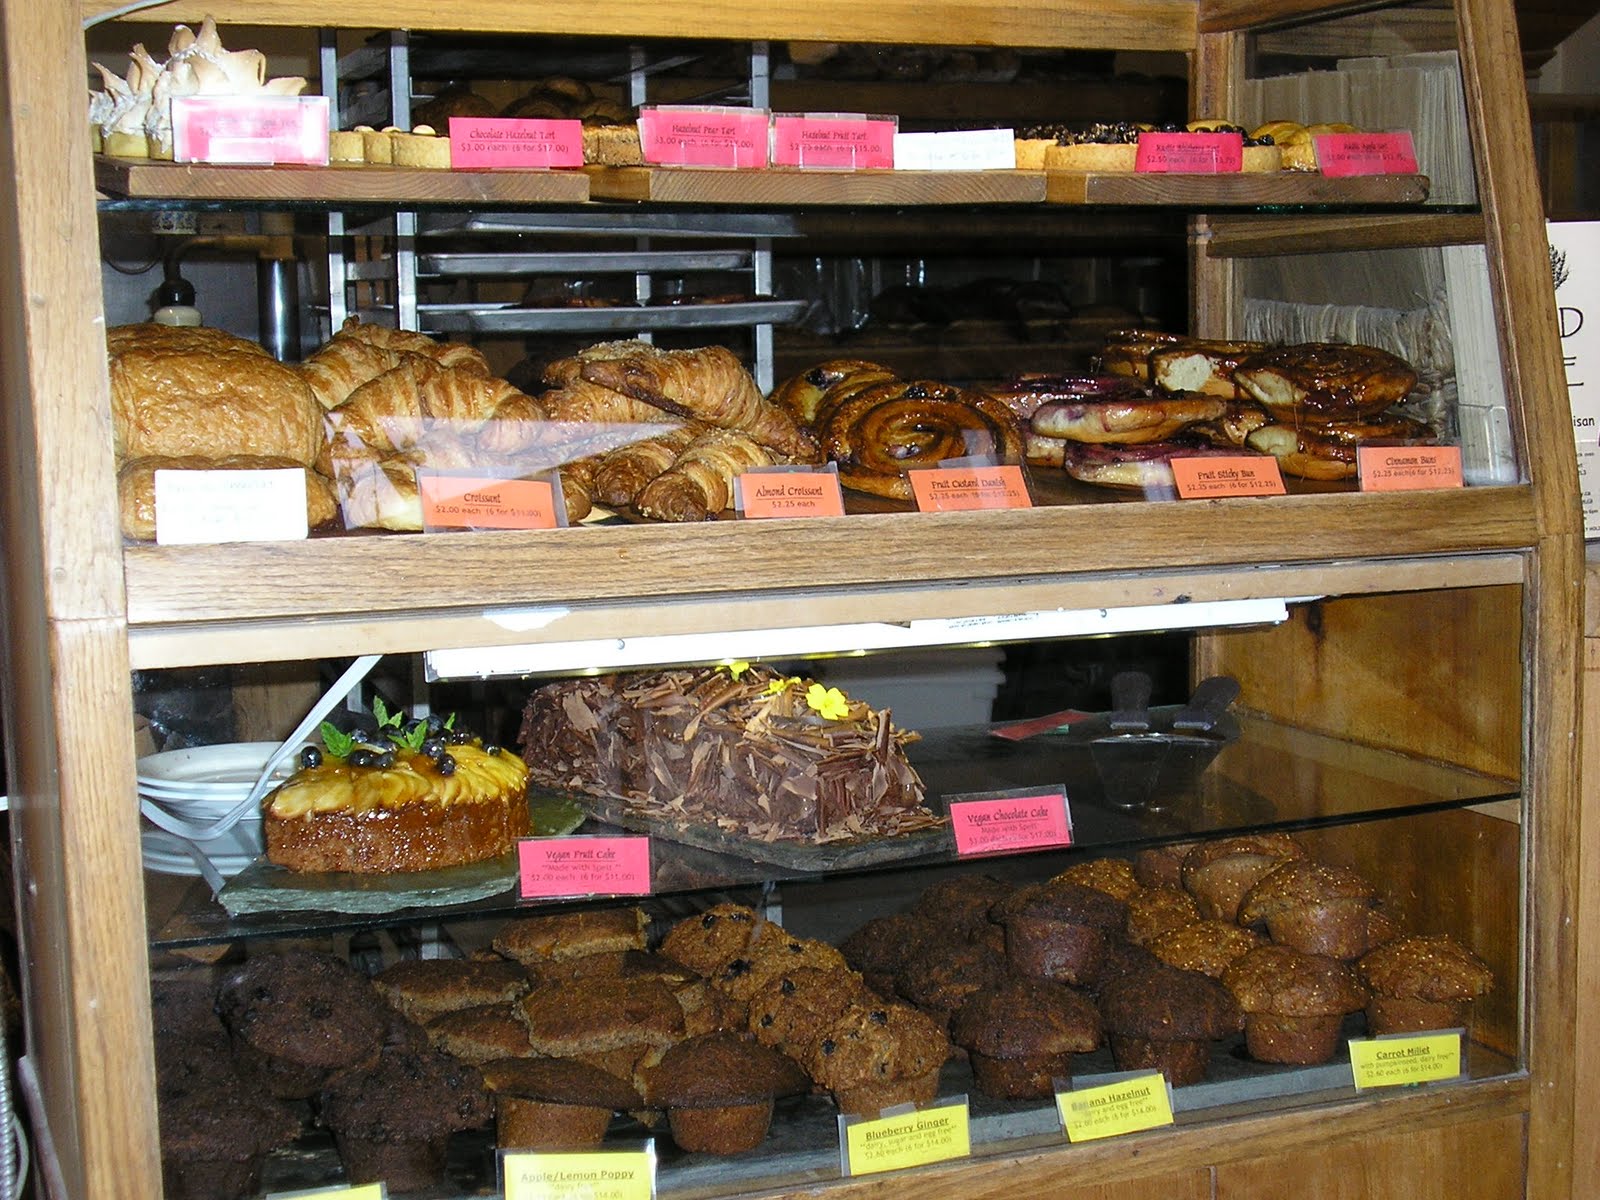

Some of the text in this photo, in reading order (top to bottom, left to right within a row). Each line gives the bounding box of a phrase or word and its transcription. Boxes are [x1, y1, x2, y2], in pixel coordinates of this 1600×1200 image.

[540, 130, 556, 140] Tart
[460, 142, 486, 152] $3.00
[487, 143, 507, 152] each
[522, 144, 536, 152] for
[1217, 468, 1239, 480] Sticky
[1372, 470, 1392, 478] $2.25
[756, 484, 823, 497] Almond Croissant
[464, 492, 502, 503] Croissant
[772, 500, 796, 508] $2.25
[436, 505, 460, 514] $2.00
[462, 506, 480, 514] each
[496, 508, 508, 516] for
[967, 806, 1049, 826] Vegan Chocolate Cake
[546, 848, 616, 862] Vegan Fruit Cake
[1376, 1046, 1430, 1060] Carrot Millet
[1108, 1086, 1151, 1102] Hazelnut
[866, 1117, 950, 1141] Blueberry Ginger
[910, 1132, 922, 1141] and
[923, 1130, 937, 1139] egg
[886, 1147, 904, 1156] each
[914, 1140, 924, 1149] for
[521, 1169, 635, 1183] Apple/Lemon Poppy
